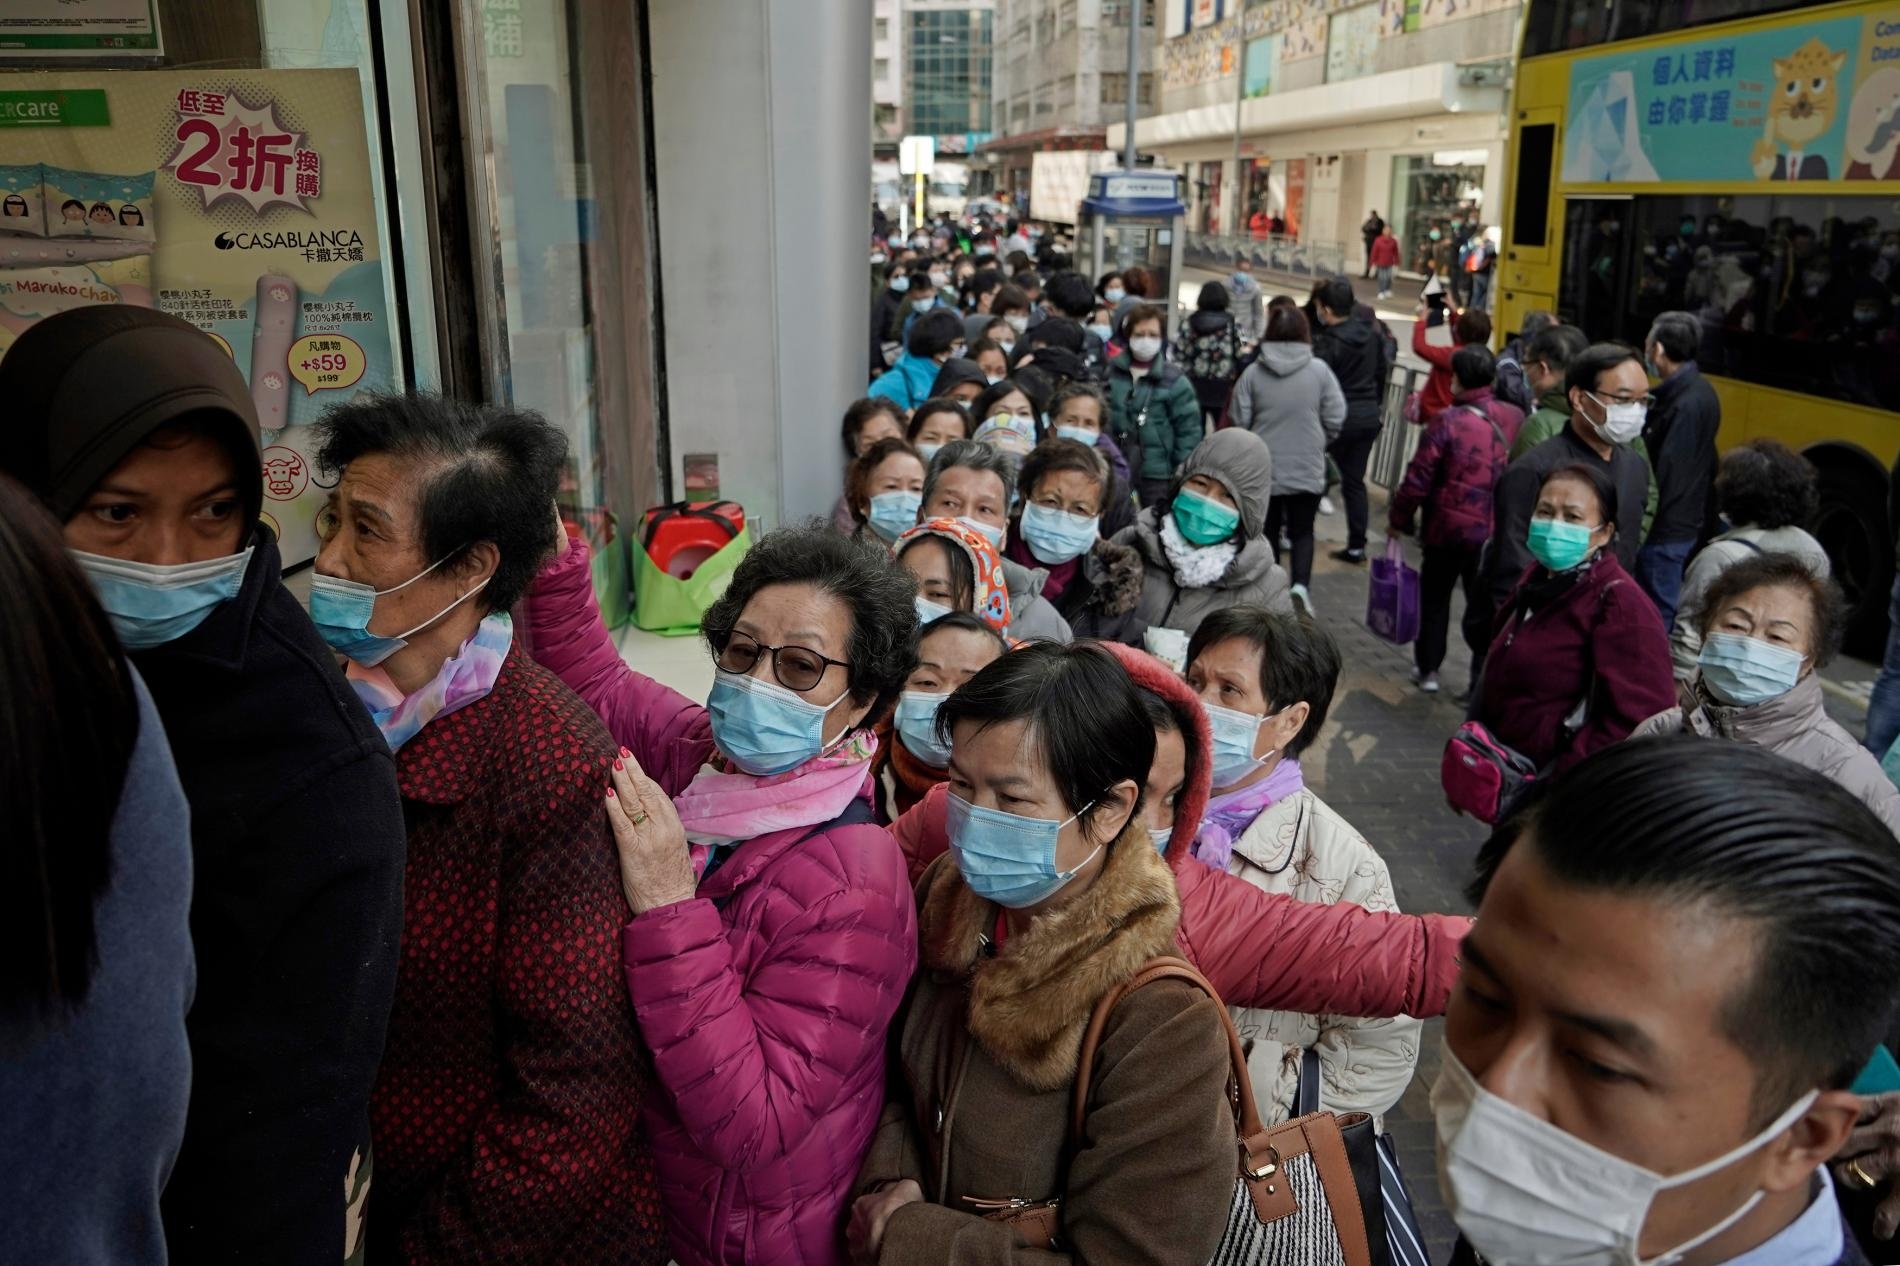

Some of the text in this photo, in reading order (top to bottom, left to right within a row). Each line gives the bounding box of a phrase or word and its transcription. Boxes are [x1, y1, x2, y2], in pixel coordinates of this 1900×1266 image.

[1653, 47, 1735, 85] 個人資料
[177, 89, 225, 115] 低至
[1648, 90, 1731, 124] 由你掌握
[176, 119, 293, 195] 2折
[296, 150, 319, 196] 換購
[236, 230, 364, 250] CASABLANCA
[16, 280, 78, 295] Maruko
[167, 310, 249, 320] 棉系列被袋套裝
[303, 301, 355, 313] 櫻桃小丸子
[309, 341, 341, 352] 凡購物
[301, 354, 346, 371] +$59
